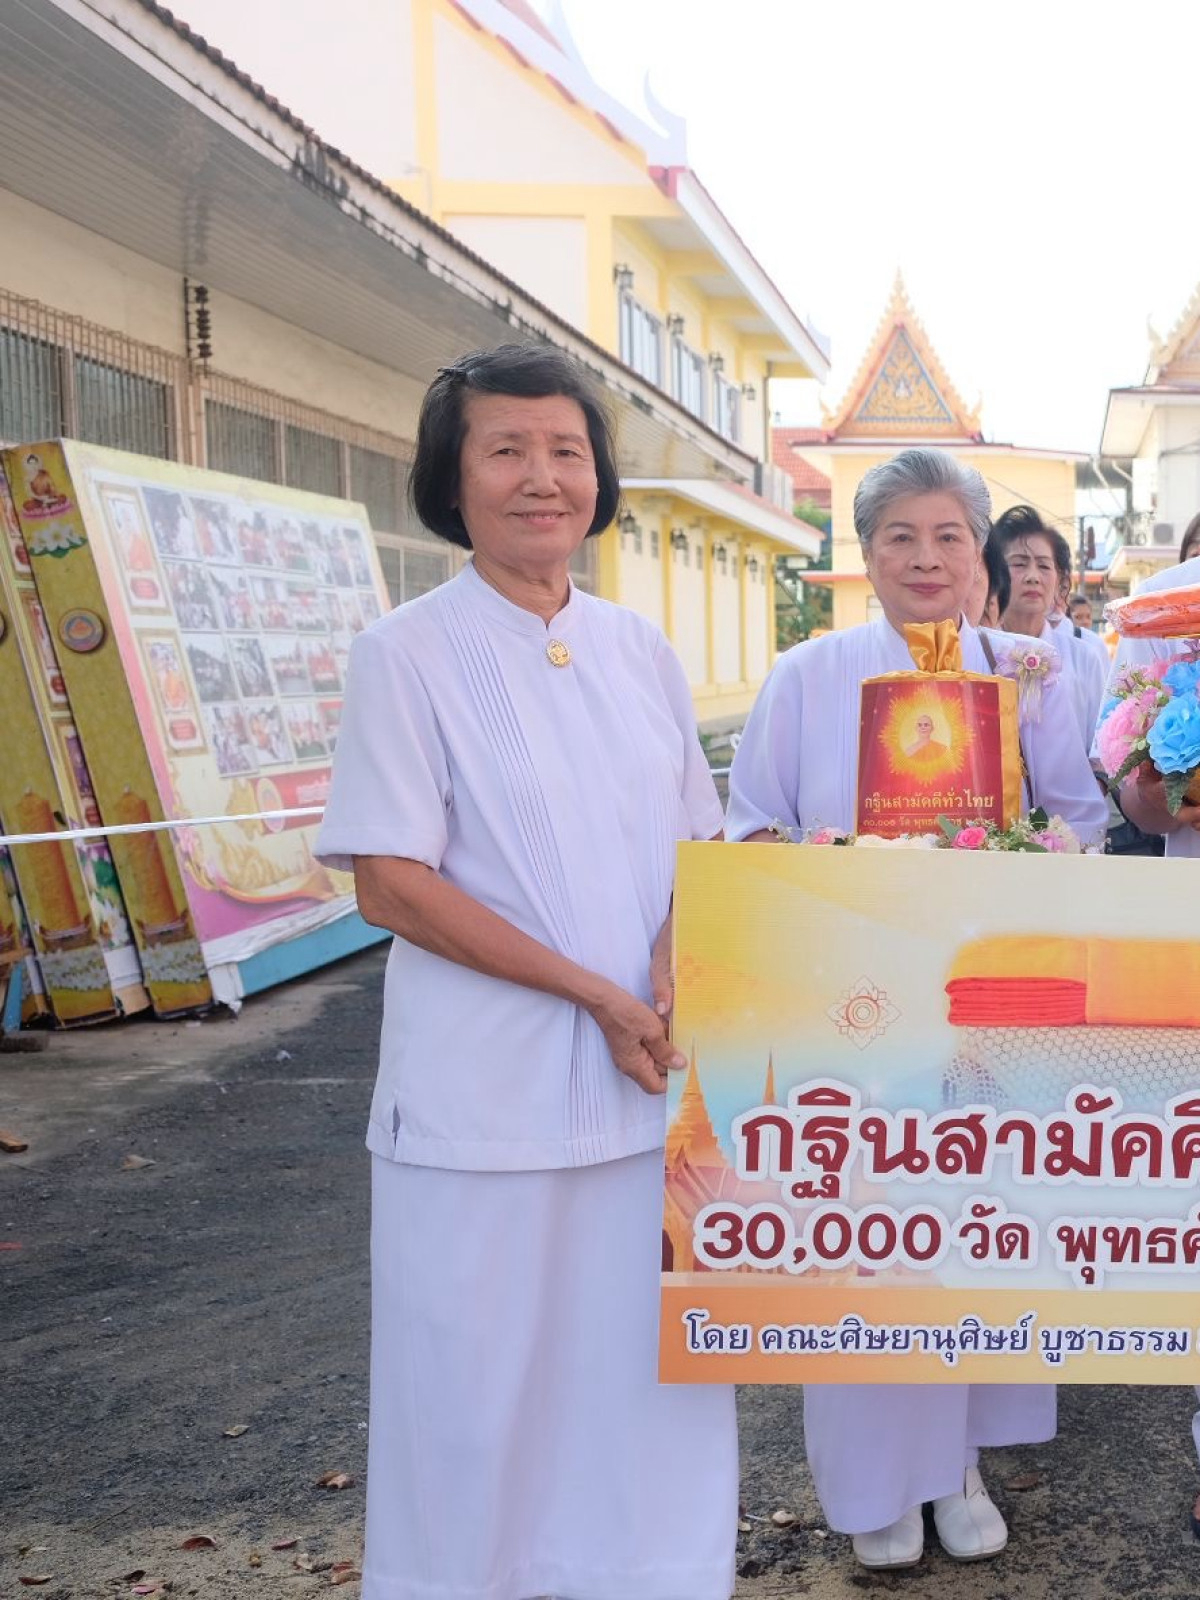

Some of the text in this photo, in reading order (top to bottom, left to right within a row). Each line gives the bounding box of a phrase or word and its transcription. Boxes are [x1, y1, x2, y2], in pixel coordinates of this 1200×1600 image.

[702, 1211, 942, 1264] 30,000
[959, 1203, 1030, 1260] วัด
[685, 1313, 749, 1350] โดย
[761, 1314, 1034, 1363] คณะศิษยานุศิษย์
[1041, 1328, 1189, 1363] บูชาธรรม
